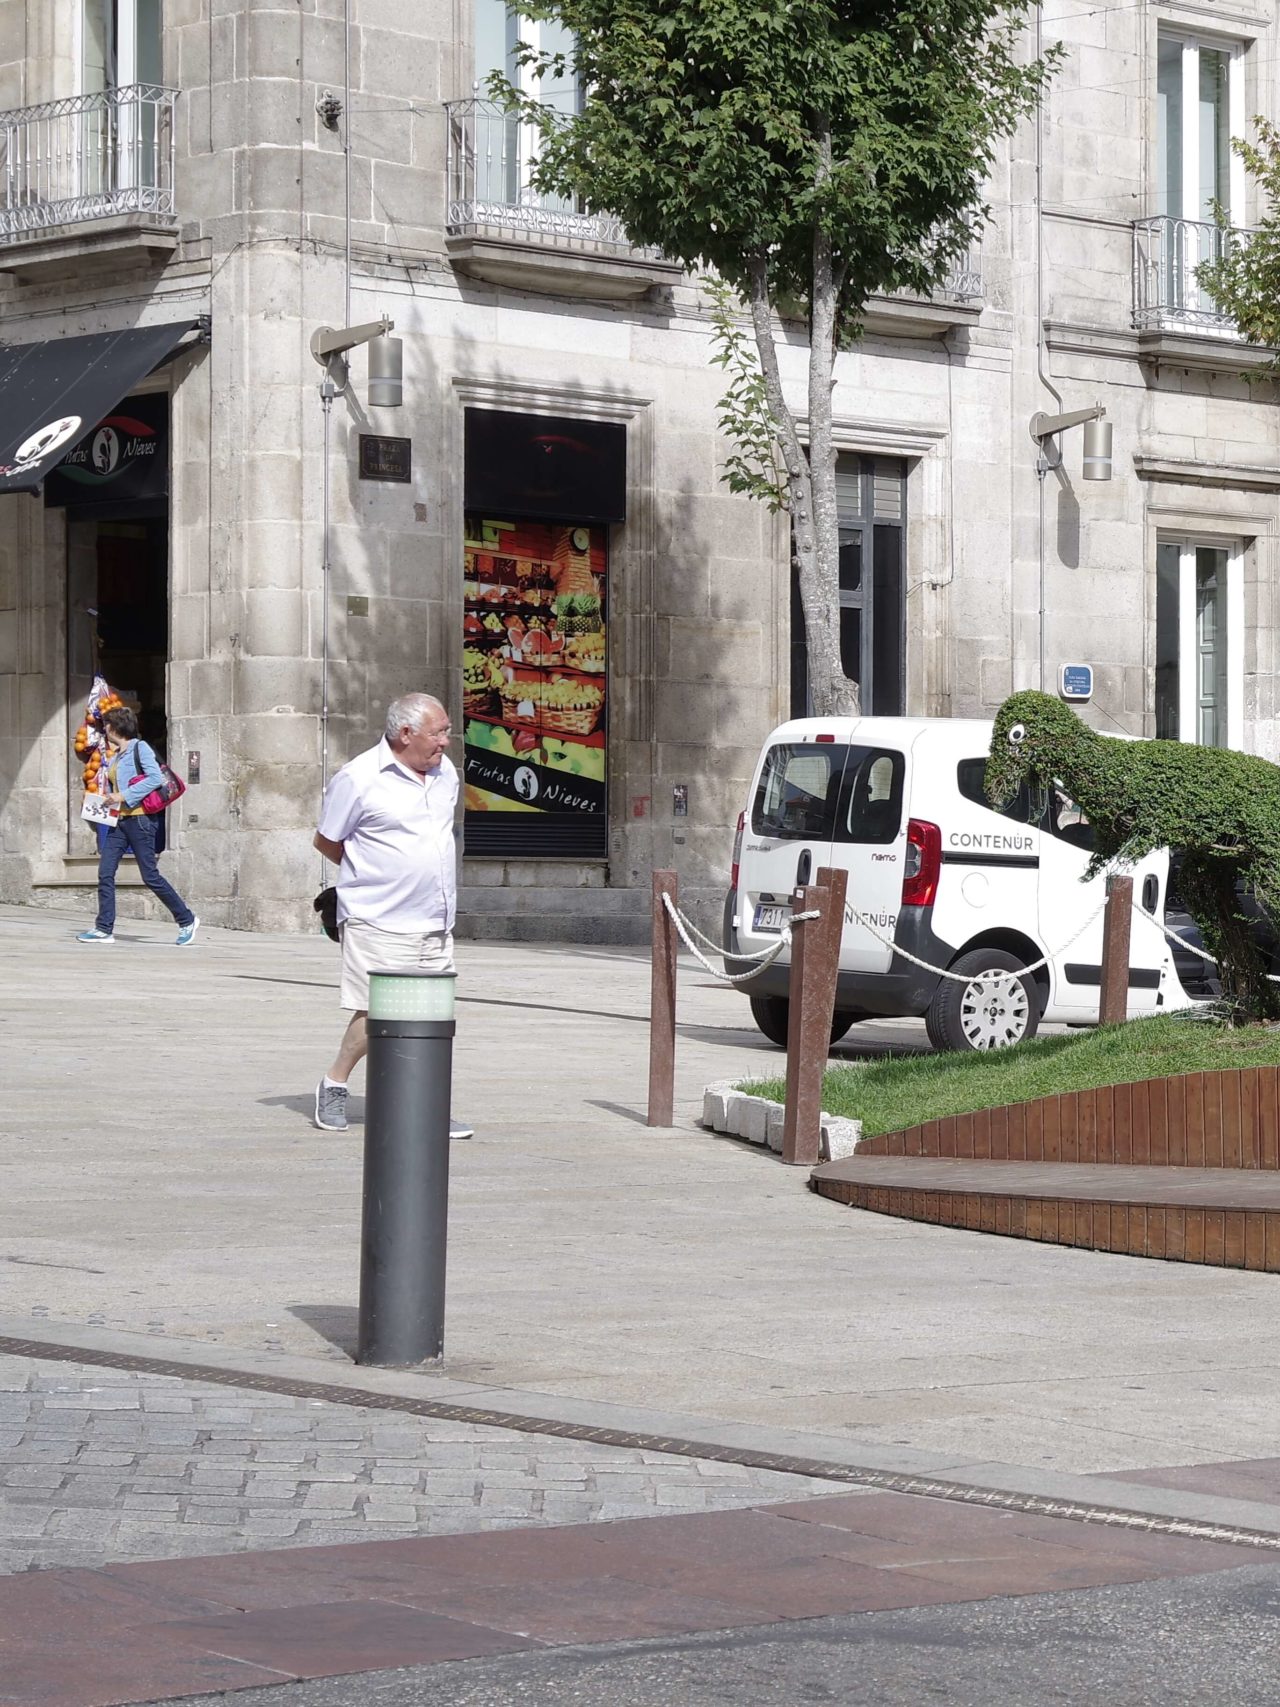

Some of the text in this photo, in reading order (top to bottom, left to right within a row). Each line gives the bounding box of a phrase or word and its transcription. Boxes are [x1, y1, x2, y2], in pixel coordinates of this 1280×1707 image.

[123, 437, 157, 459] Nieves
[467, 759, 597, 812] Frutas Nieves
[761, 908, 784, 926] 7311
